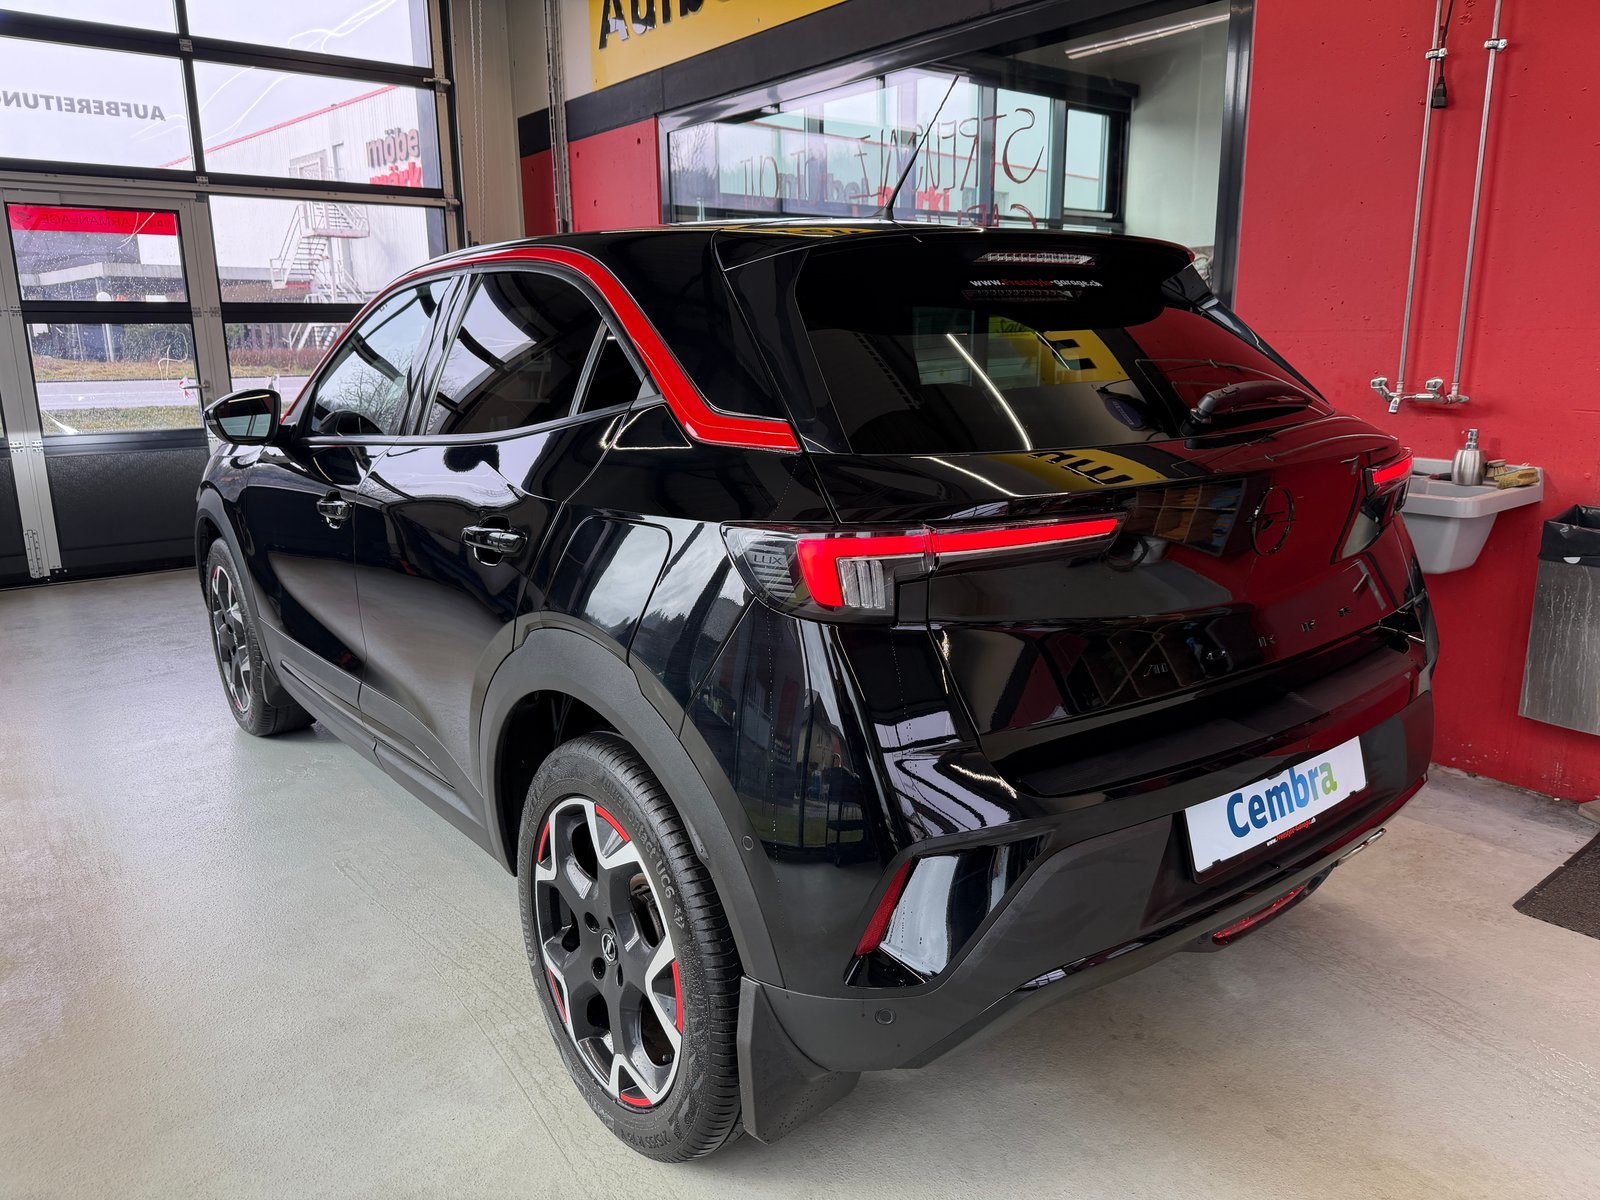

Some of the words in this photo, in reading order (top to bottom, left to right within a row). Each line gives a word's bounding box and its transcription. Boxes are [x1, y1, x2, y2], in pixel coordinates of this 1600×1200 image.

[753, 554, 783, 565] LUX
[1226, 762, 1338, 838] Cembra
[655, 860, 676, 899] UC6
